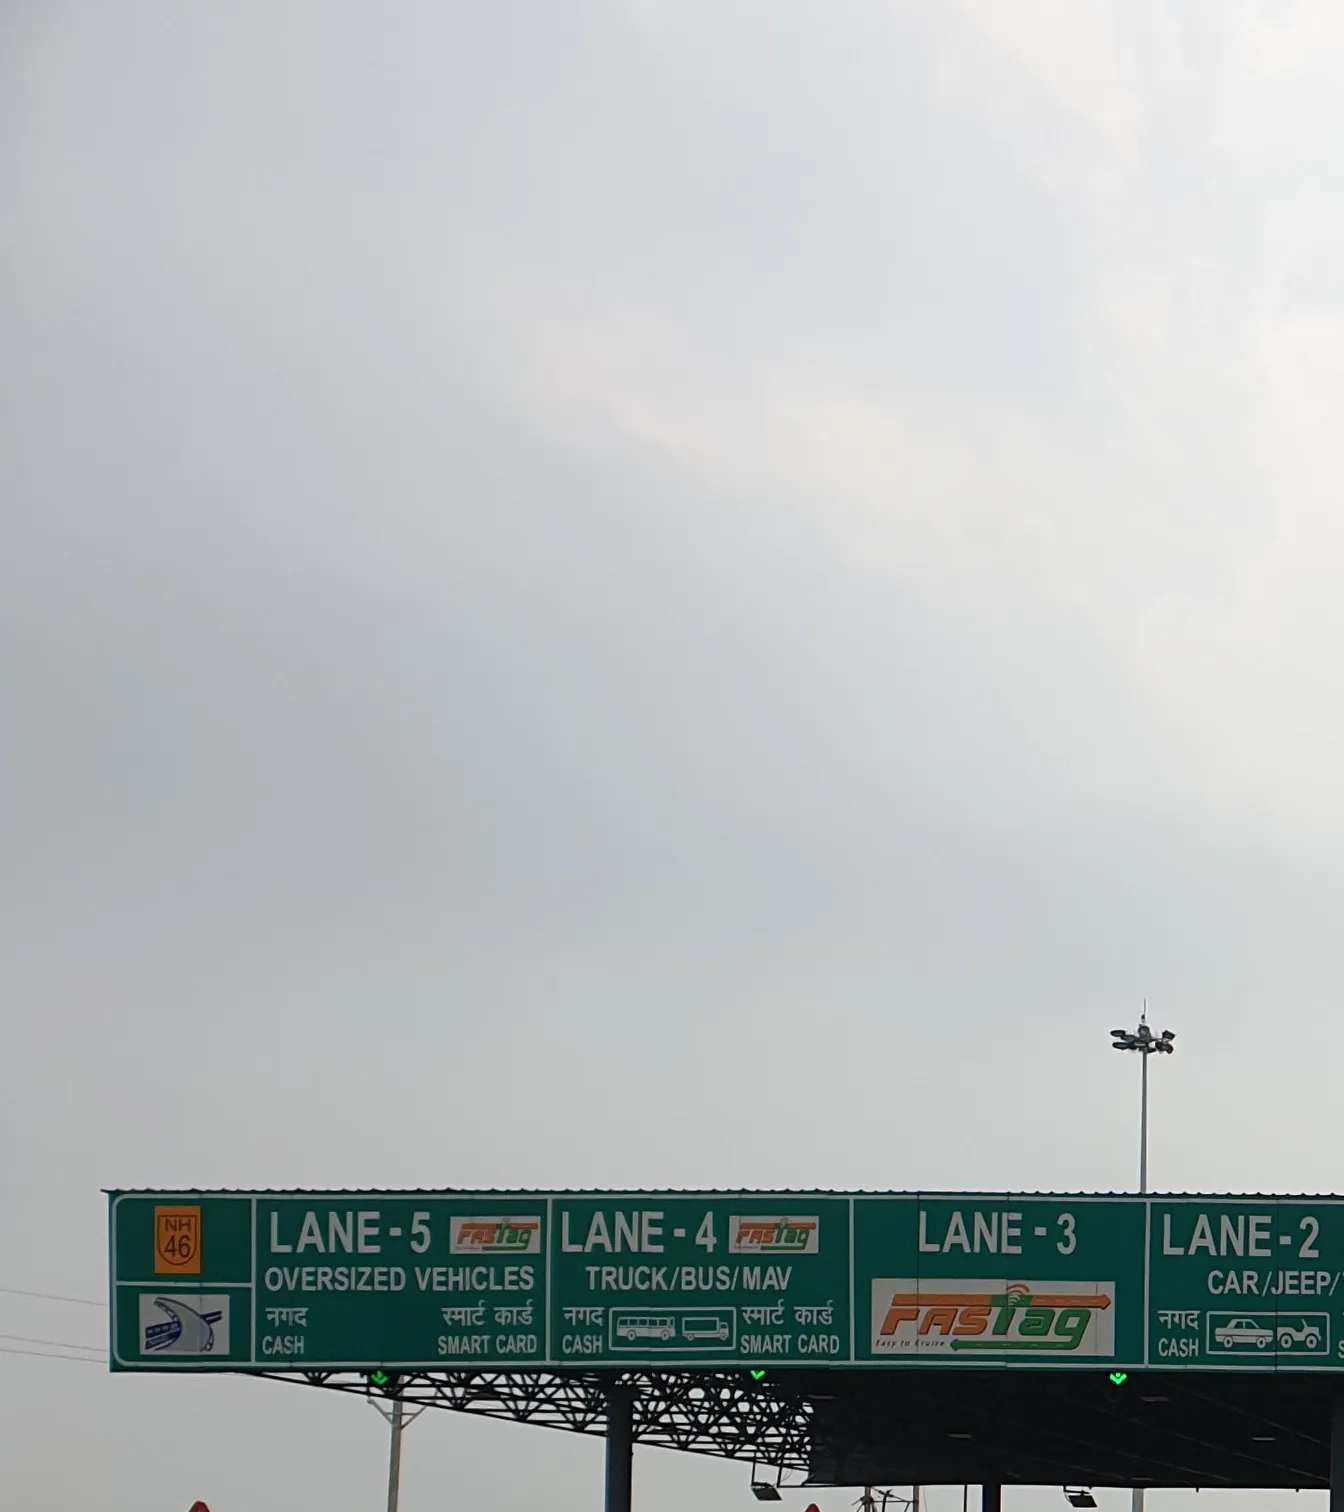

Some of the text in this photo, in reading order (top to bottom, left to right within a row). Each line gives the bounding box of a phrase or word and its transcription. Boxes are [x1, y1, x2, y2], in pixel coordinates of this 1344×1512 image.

[165, 1219, 191, 1232] NH
[164, 1235, 191, 1258] 46
[265, 1266, 534, 1291] OVERSIZED VEHICLES
[266, 1308, 308, 1326] नगद
[442, 1299, 533, 1326] स्मार्ट कार्ड
[563, 1307, 605, 1326] नगद
[741, 1299, 833, 1325] स्मार्ट कार्ड
[1158, 1311, 1200, 1329] नगद
[263, 1336, 304, 1354] CASH
[438, 1335, 537, 1354] SMART CARD
[563, 1335, 602, 1353] CASH
[741, 1335, 839, 1353] SMART CARD
[875, 1339, 897, 1349] Easy
[1159, 1338, 1198, 1357] CASH
